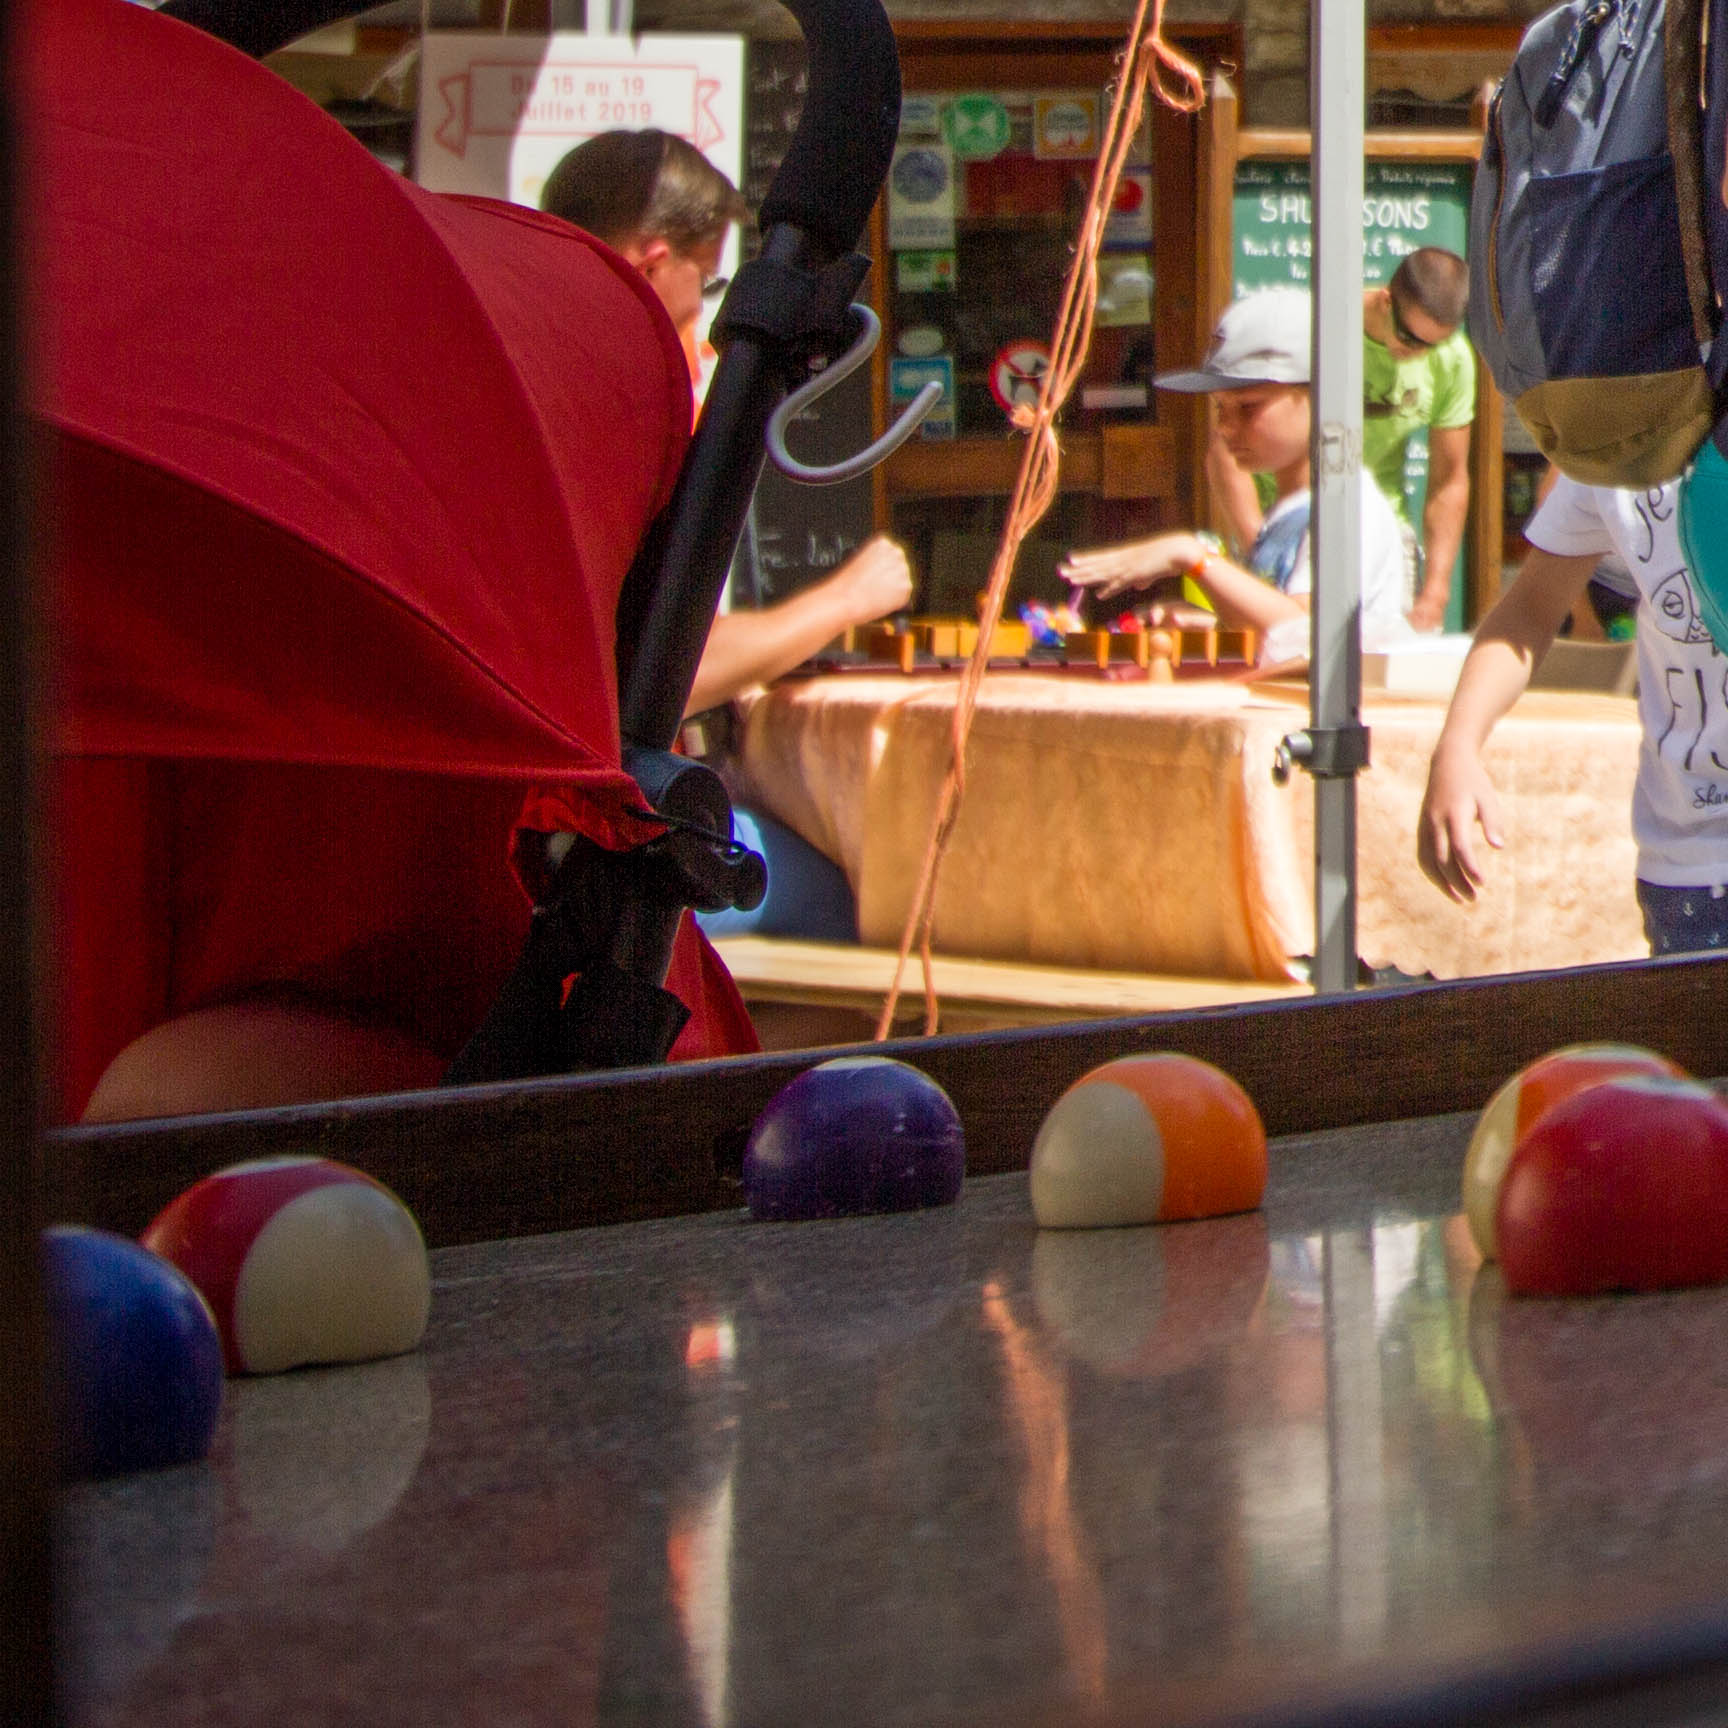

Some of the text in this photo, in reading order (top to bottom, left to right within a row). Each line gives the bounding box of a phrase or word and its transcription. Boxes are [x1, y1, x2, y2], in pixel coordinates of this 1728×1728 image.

[552, 76, 575, 96] 15
[623, 76, 646, 97] 19
[599, 102, 652, 123] 2019
